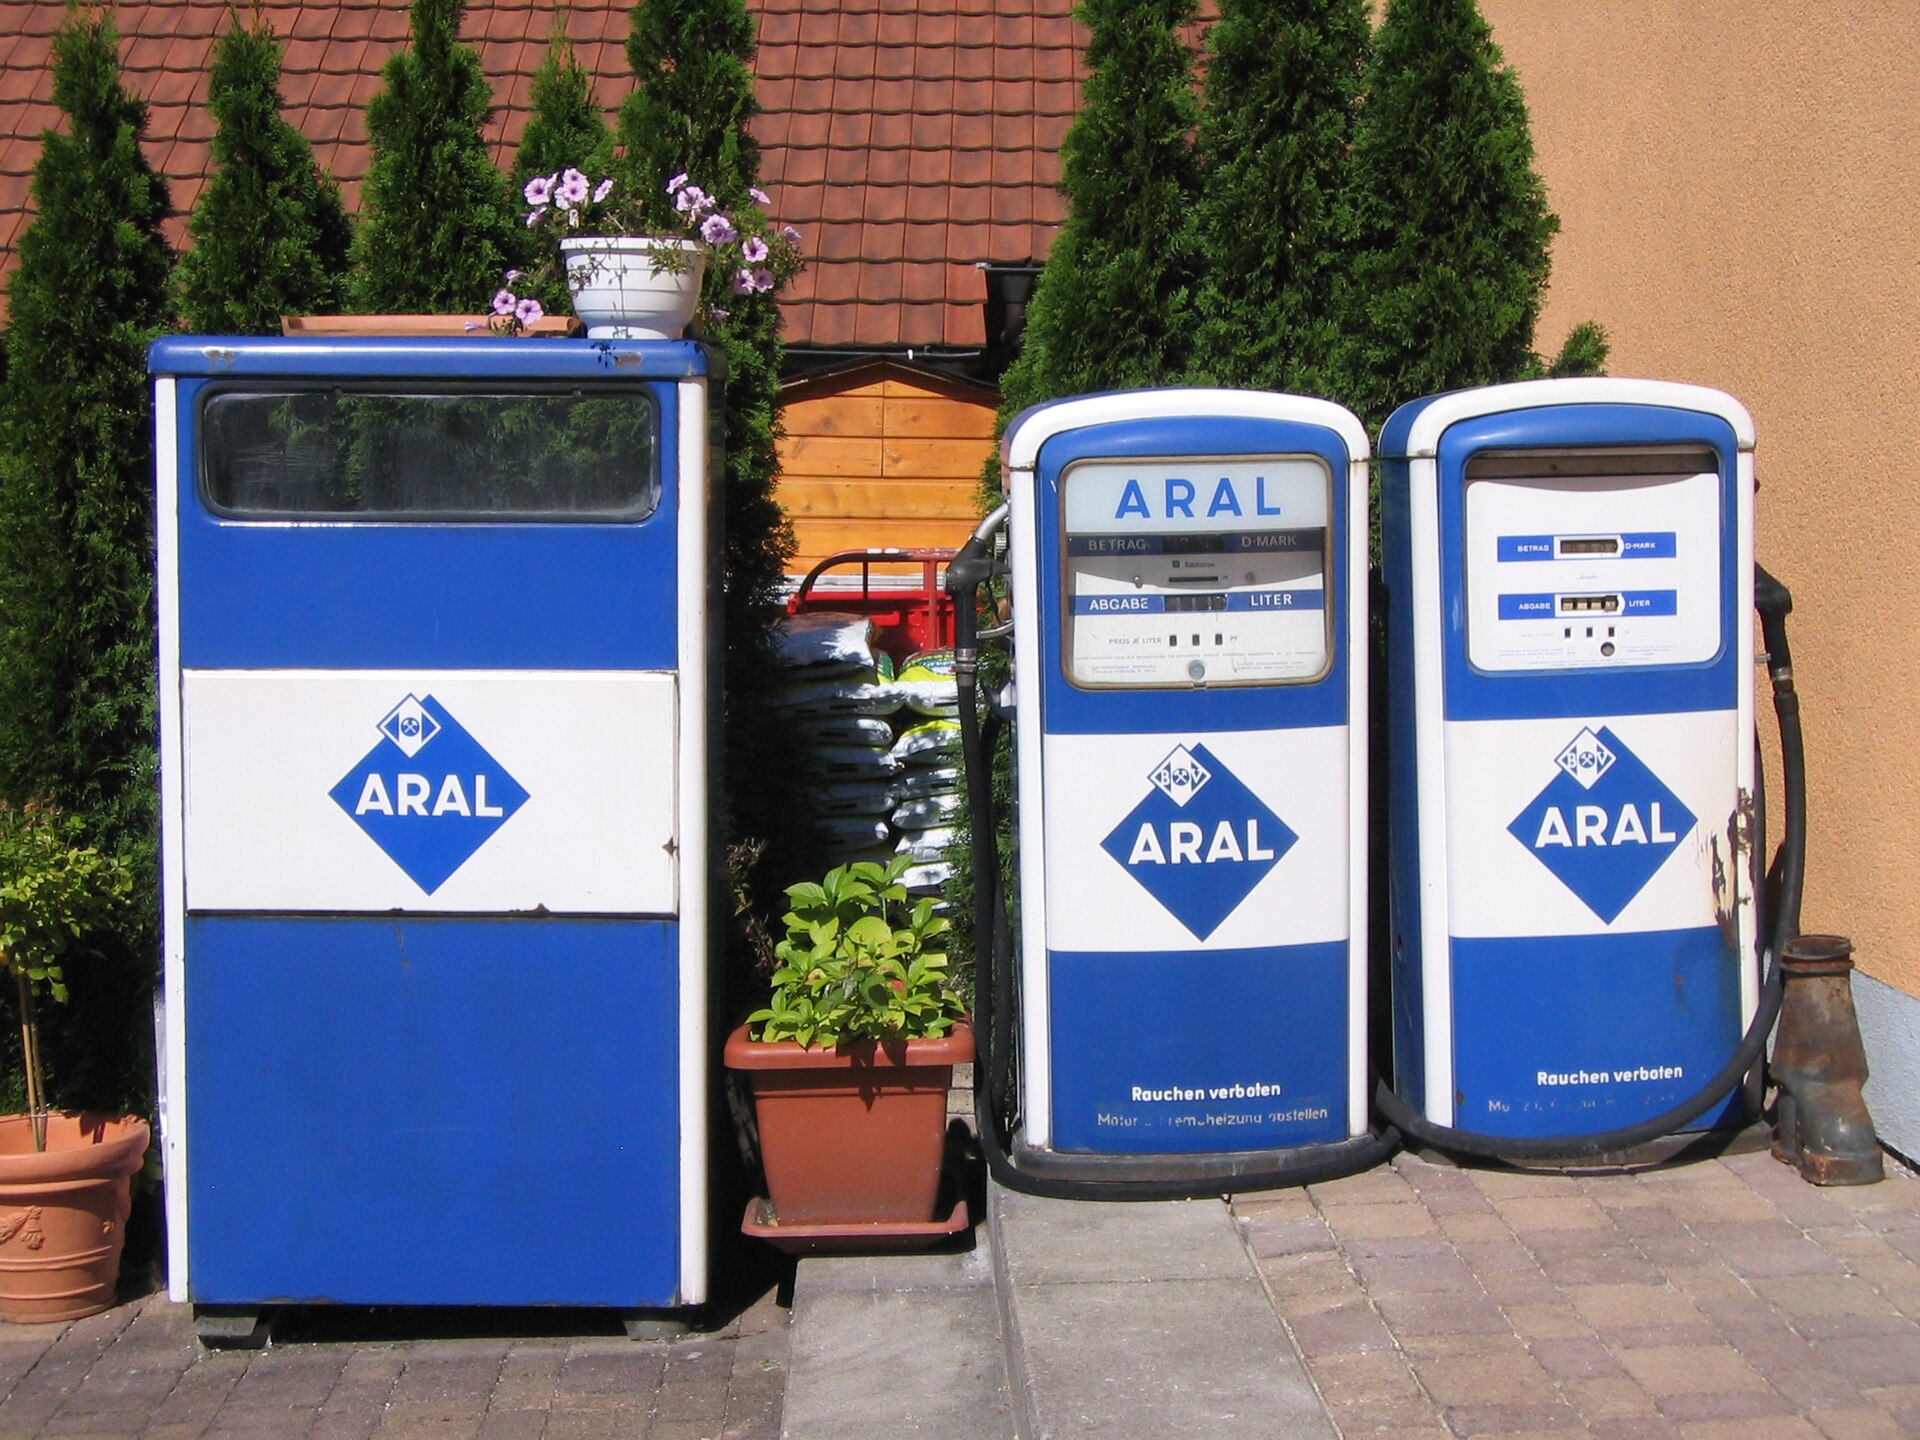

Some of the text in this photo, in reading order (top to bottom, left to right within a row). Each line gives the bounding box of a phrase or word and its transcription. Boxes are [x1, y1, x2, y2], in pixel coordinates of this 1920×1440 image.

[1115, 477, 1281, 519] ARAL
[1088, 539, 1147, 551] BETRAG
[1517, 544, 1550, 552] BETRAG
[1089, 594, 1292, 611] ABGABE LITER
[1629, 600, 1651, 608] LITER
[354, 773, 504, 817] ARAL
[1535, 802, 1677, 848] ARAL
[1128, 819, 1275, 865] ARAL
[1537, 1066, 1683, 1086] Rauchen verboten
[1132, 1082, 1281, 1102] Rauchen verboten
